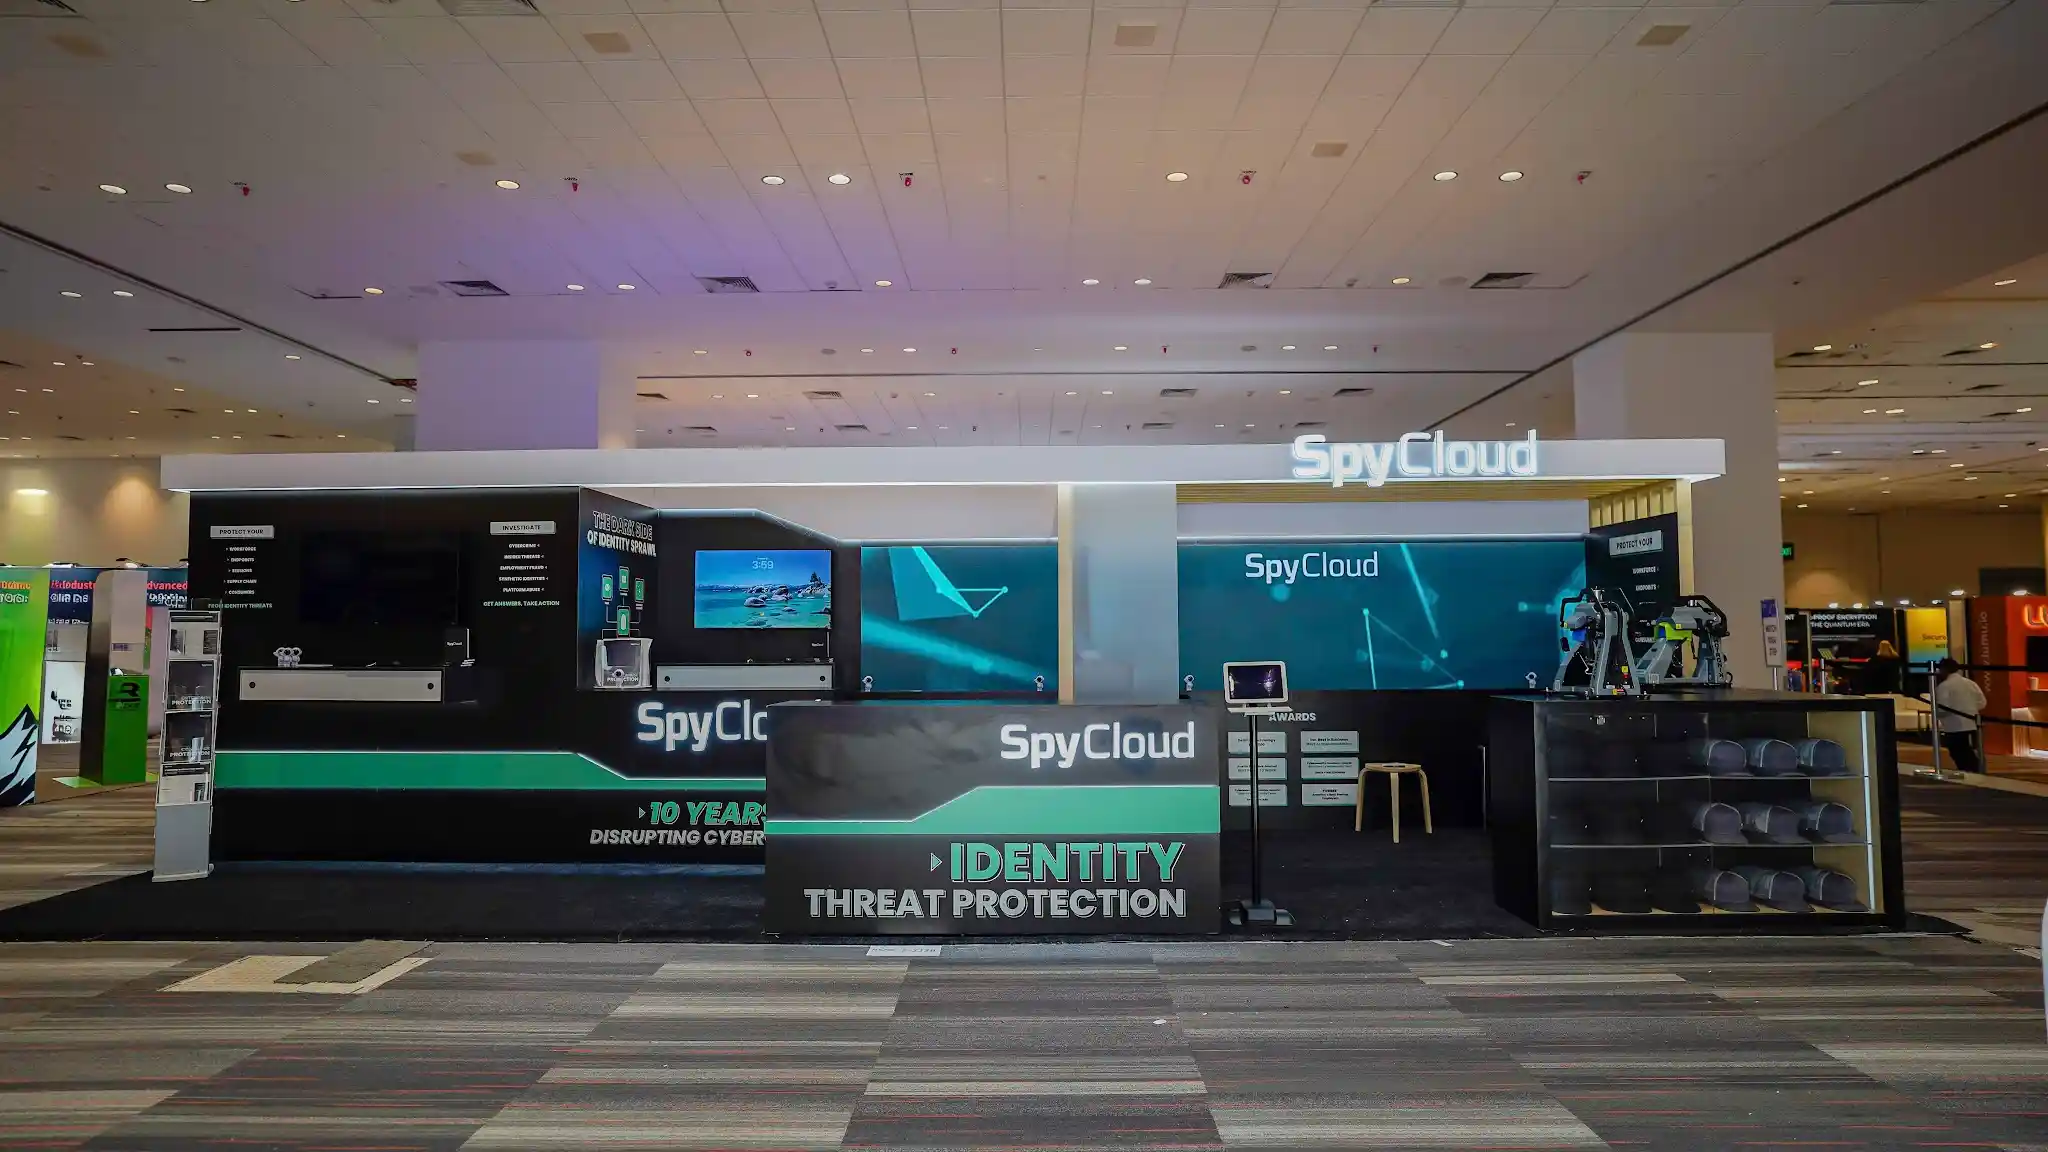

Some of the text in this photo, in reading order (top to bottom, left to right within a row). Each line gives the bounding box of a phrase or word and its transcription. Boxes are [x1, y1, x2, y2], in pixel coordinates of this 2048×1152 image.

[1292, 429, 1538, 488] SpyCloud
[593, 510, 653, 541] THE DARK SIDE
[587, 530, 657, 557] OF IDENTITY SPRAWL
[1616, 537, 1652, 550] PROTECT YOUR
[752, 560, 774, 570] 3:59
[1244, 551, 1379, 585] SpyCloud
[1632, 566, 1656, 574] WORKFORCE
[147, 580, 188, 590] dvanced
[636, 698, 768, 752] SpyClo
[1268, 712, 1317, 722] AWARDS
[1000, 721, 1195, 769] SpyCloud
[650, 802, 680, 825] 10
[590, 829, 768, 846] DISRUPTING CYBER
[950, 842, 1186, 883] IDENTITY
[804, 888, 1187, 918] THREAT PROTECTION
